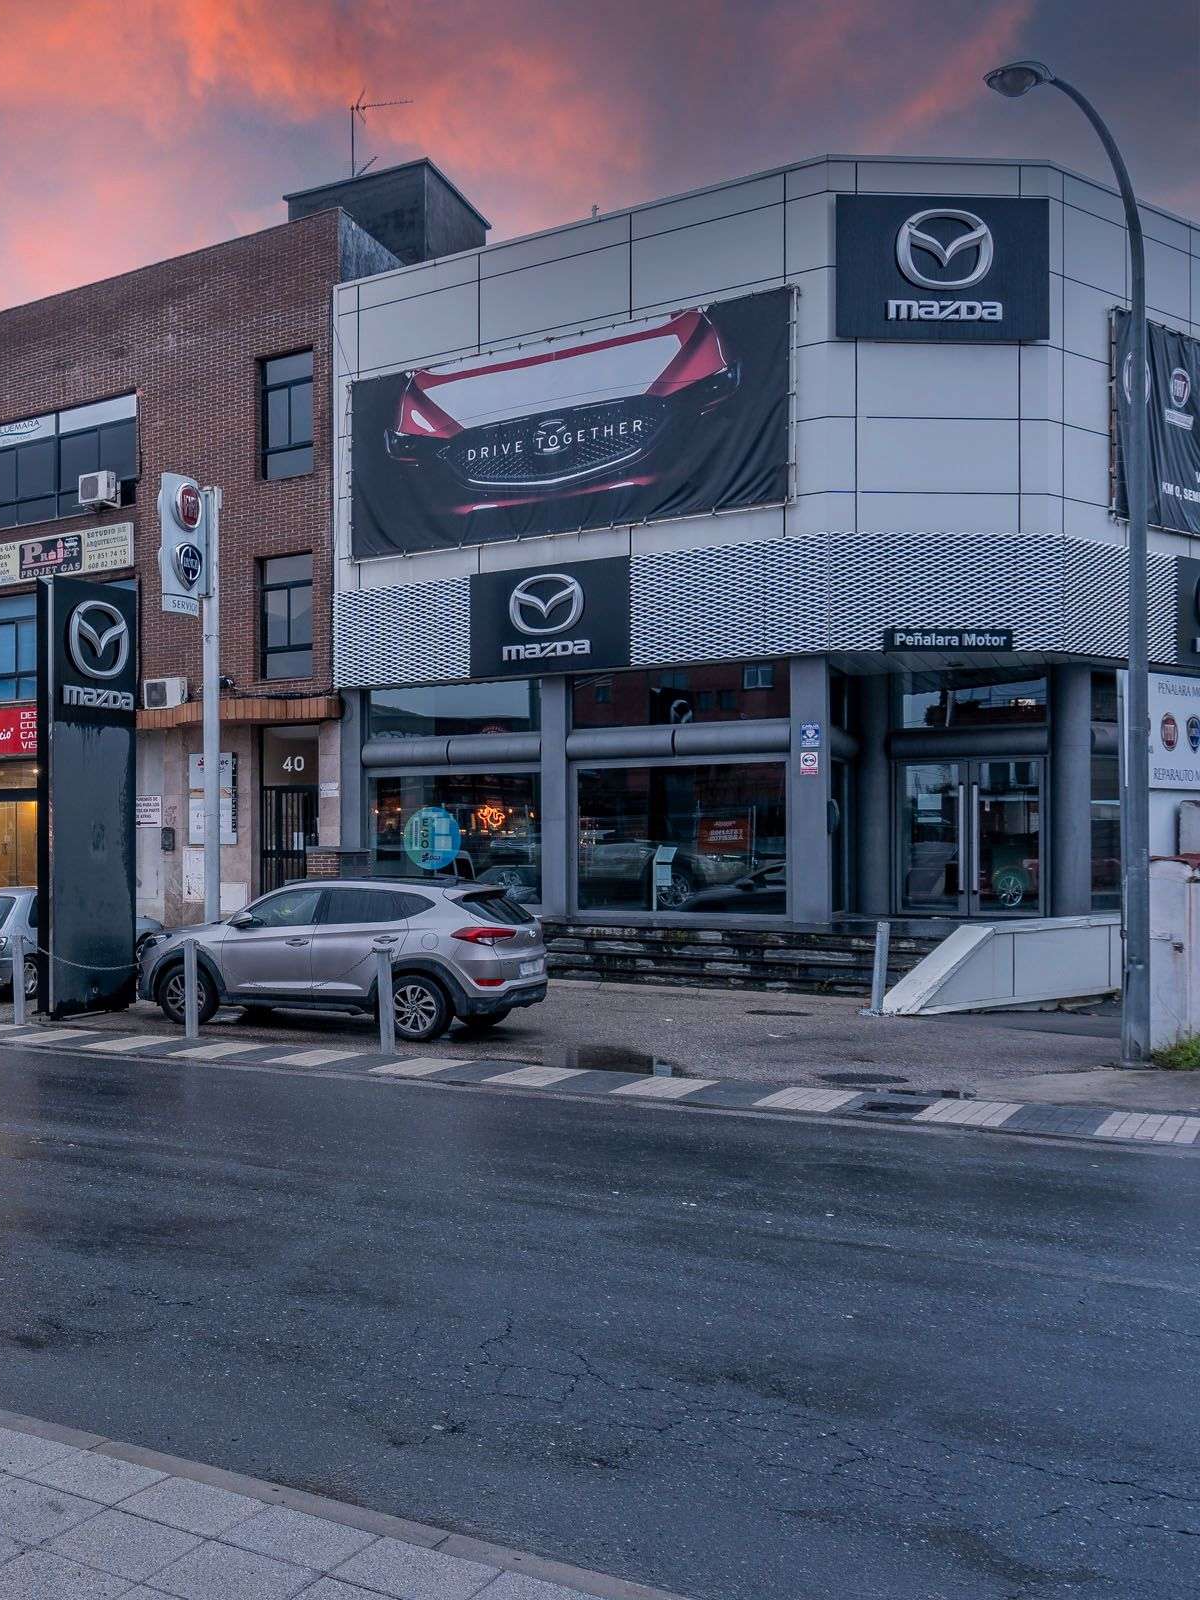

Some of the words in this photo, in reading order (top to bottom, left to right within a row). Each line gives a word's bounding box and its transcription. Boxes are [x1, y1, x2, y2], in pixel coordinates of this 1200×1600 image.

[888, 299, 1003, 321] mazda
[467, 441, 523, 461] DRIVE
[535, 419, 642, 449] TOGETHER
[1161, 481, 1174, 496] KM
[20, 565, 57, 579] PROJET
[60, 562, 81, 572] GAS
[894, 632, 959, 646] Peñalara
[962, 632, 1007, 646] Motor
[502, 639, 591, 661] mazda
[63, 684, 134, 711] mazda
[282, 756, 305, 772] 40
[1153, 767, 1193, 782] REPARAUTO
